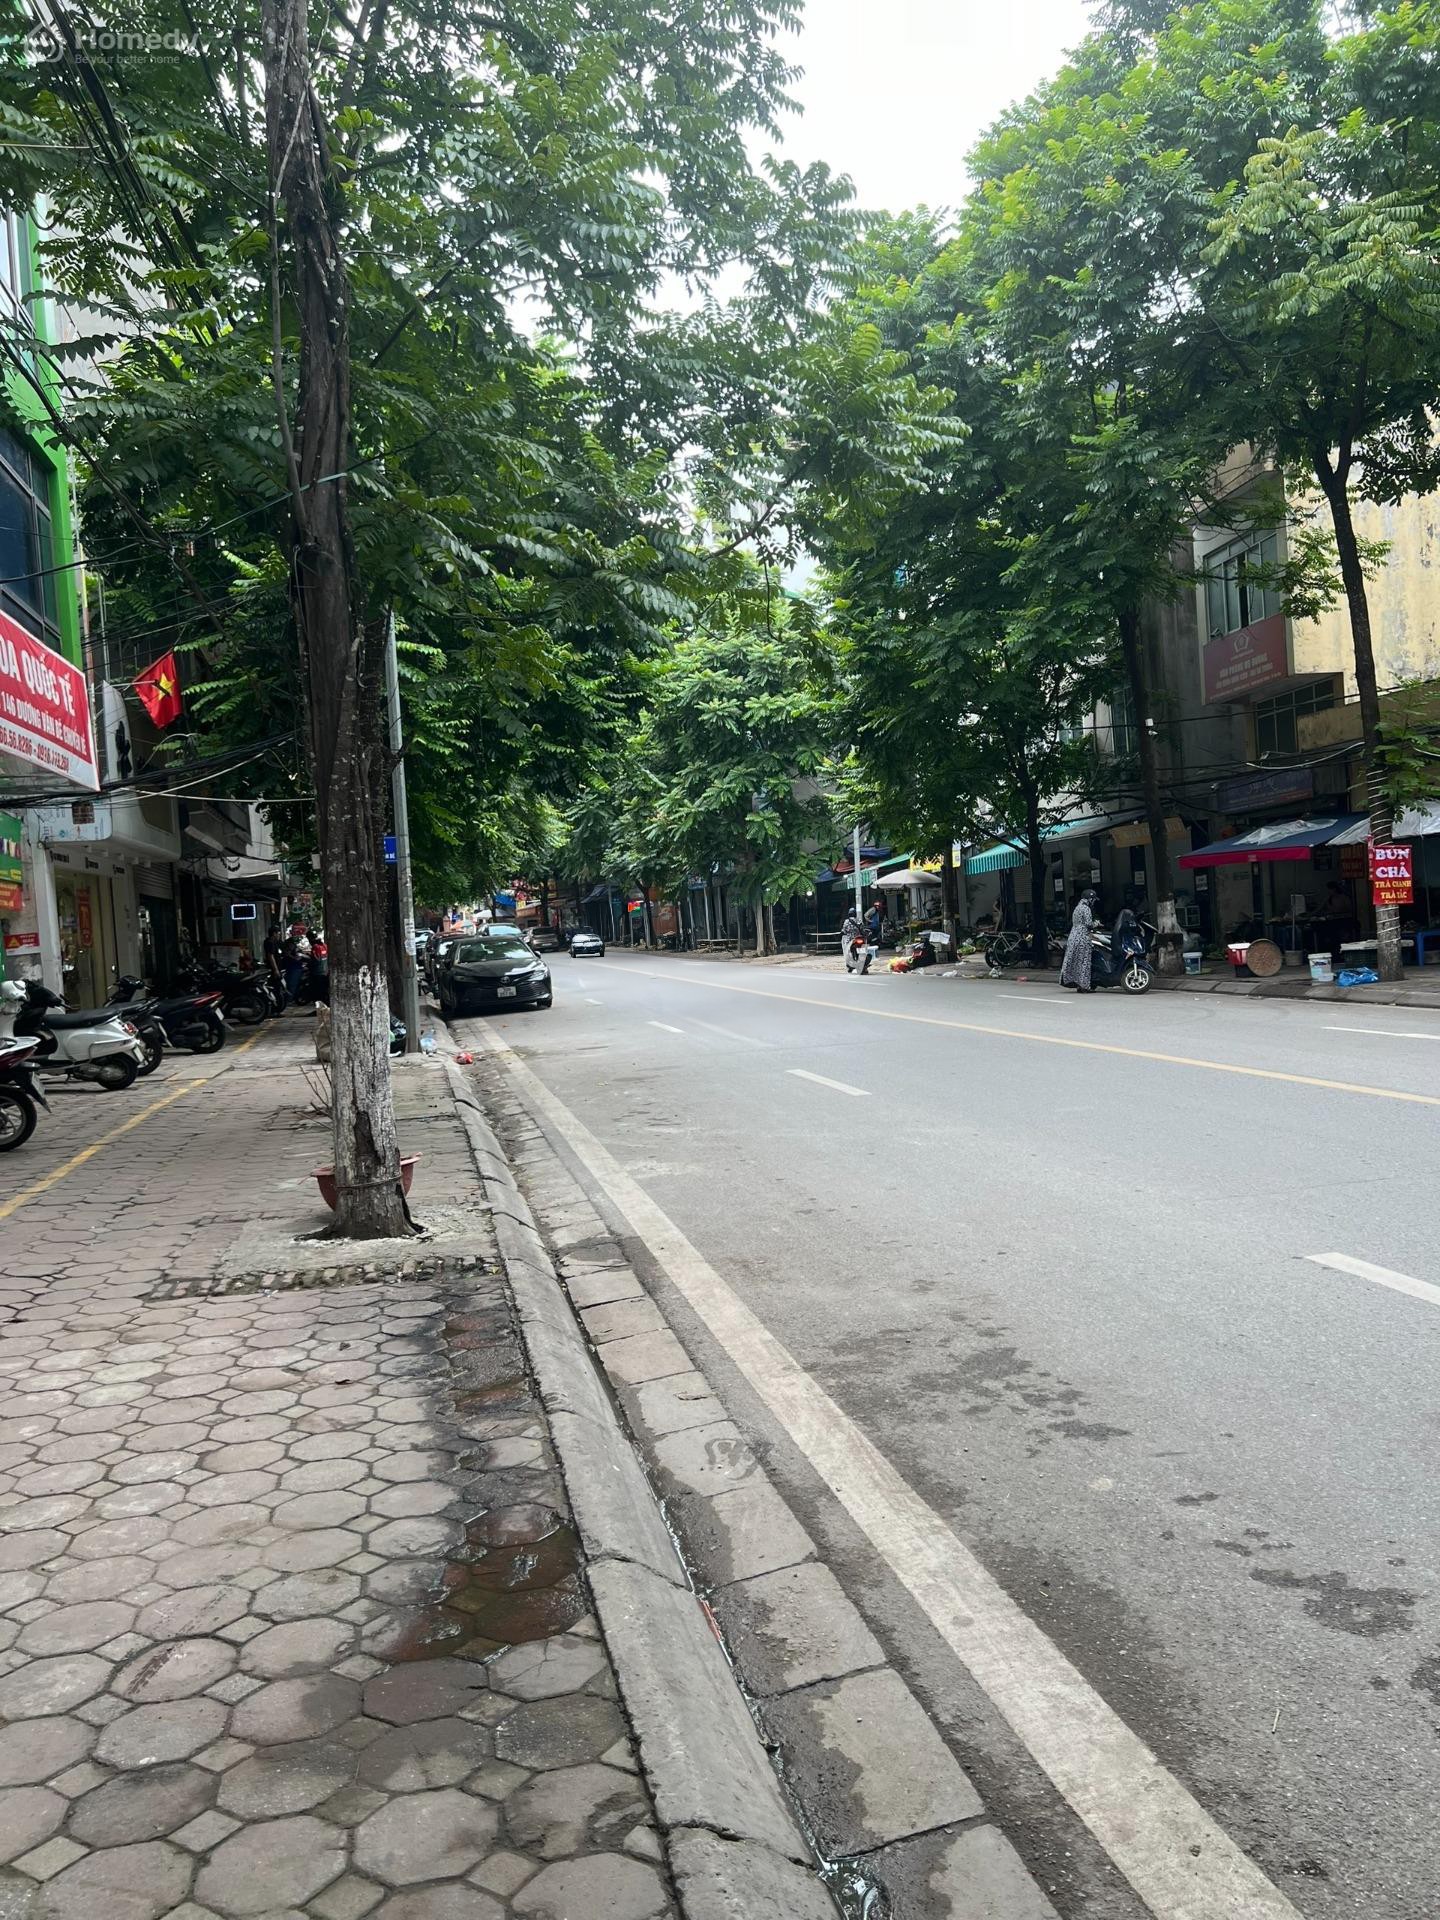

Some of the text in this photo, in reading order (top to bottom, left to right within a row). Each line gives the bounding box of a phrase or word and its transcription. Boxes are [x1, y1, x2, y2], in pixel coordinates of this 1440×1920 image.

[21, 650, 60, 705] QUỐC
[57, 673, 75, 716] TẾ
[1, 691, 16, 716] 146
[1375, 862, 1411, 878] CHẢ
